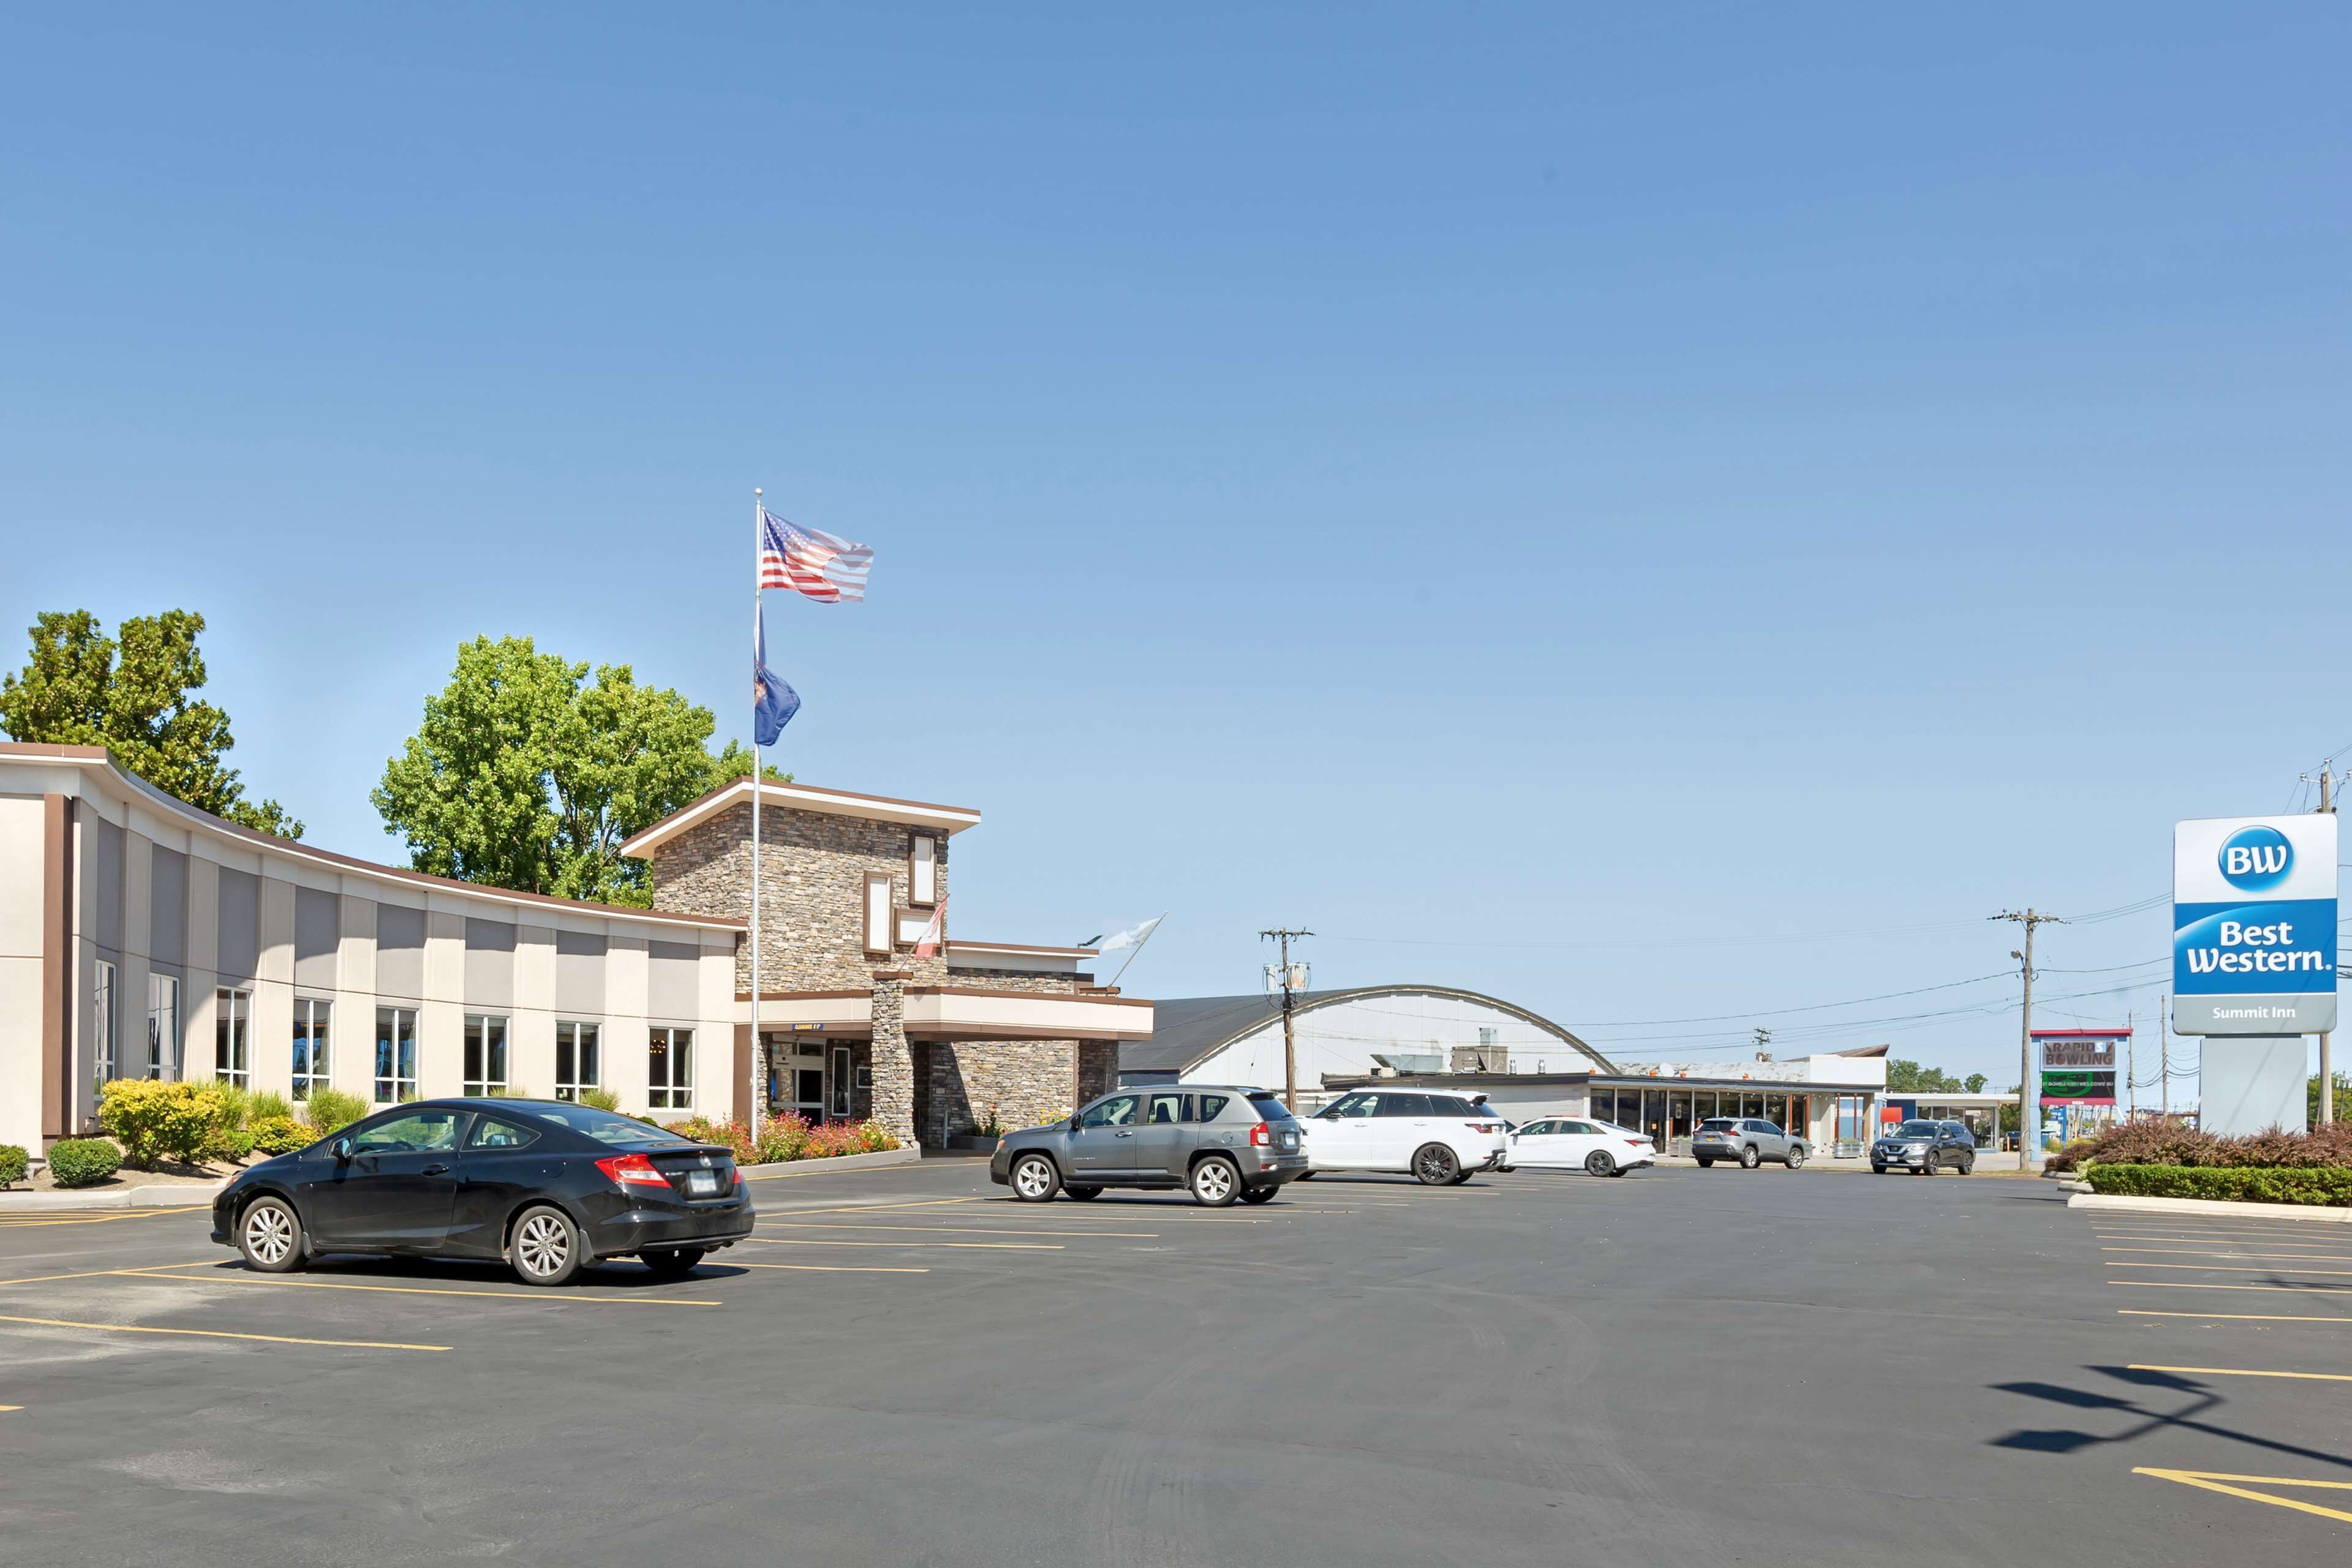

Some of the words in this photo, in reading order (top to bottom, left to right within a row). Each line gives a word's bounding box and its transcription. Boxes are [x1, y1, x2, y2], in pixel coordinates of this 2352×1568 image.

[2228, 845, 2287, 875] BW
[2220, 921, 2294, 946] Best
[2212, 1006, 2269, 1019] Summit
[2272, 1006, 2296, 1018] Inn
[2052, 1042, 2105, 1052] RAPIDS
[2046, 1054, 2113, 1065] BOWLING
